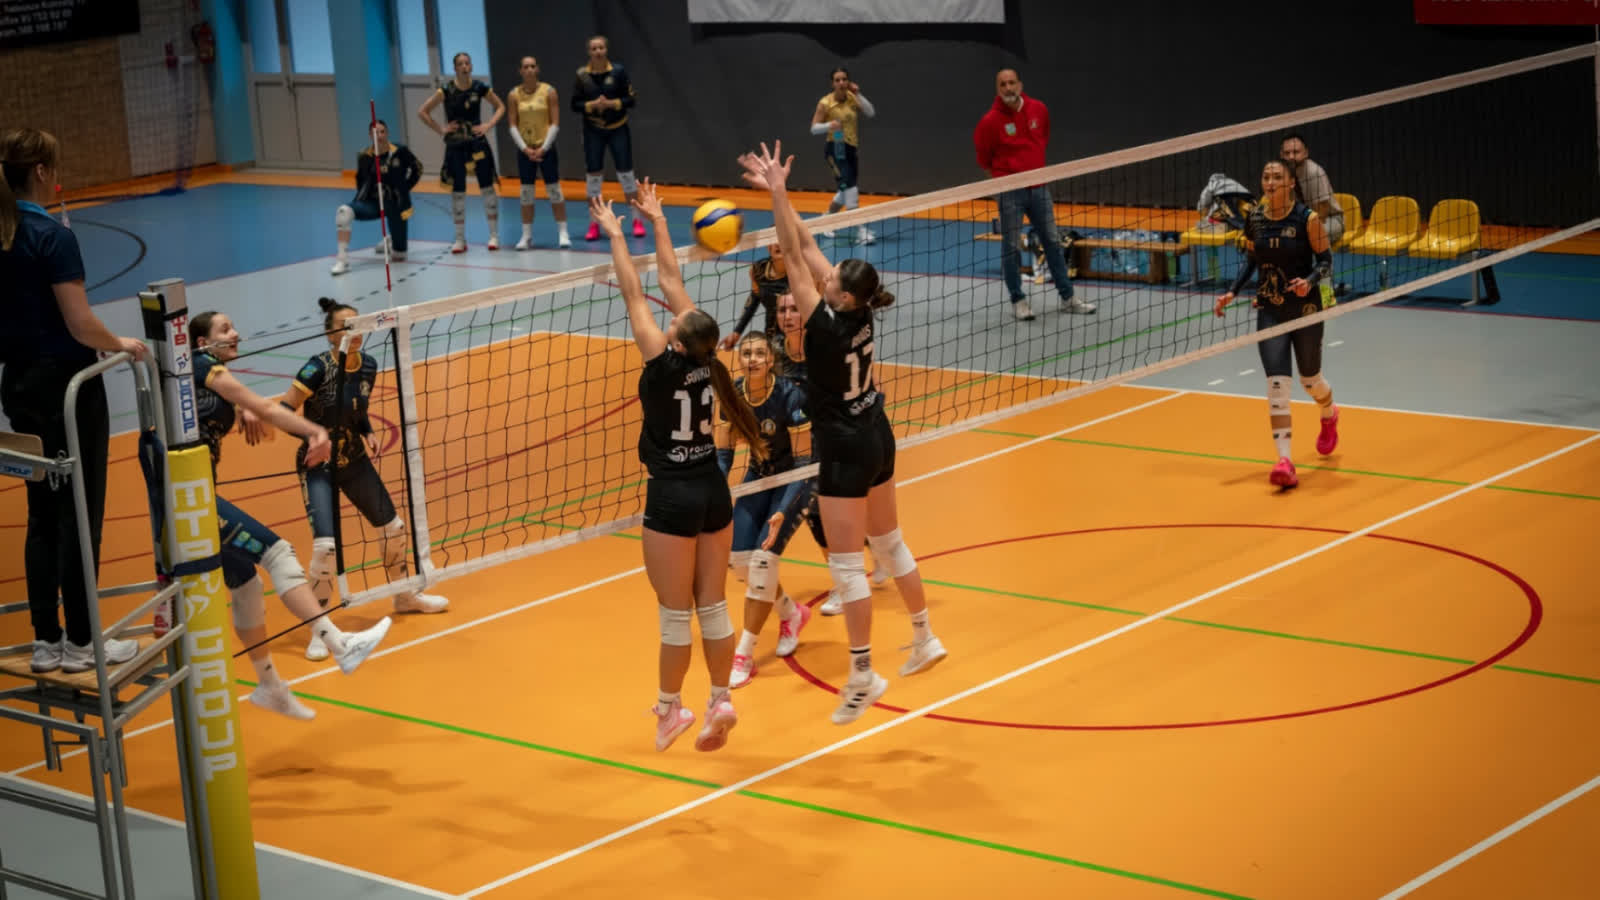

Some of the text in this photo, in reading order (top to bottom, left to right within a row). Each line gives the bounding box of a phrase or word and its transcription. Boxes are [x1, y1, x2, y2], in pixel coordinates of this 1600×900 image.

[843, 343, 875, 400] 17
[671, 385, 714, 441] 13
[190, 626, 237, 782] GROUP
